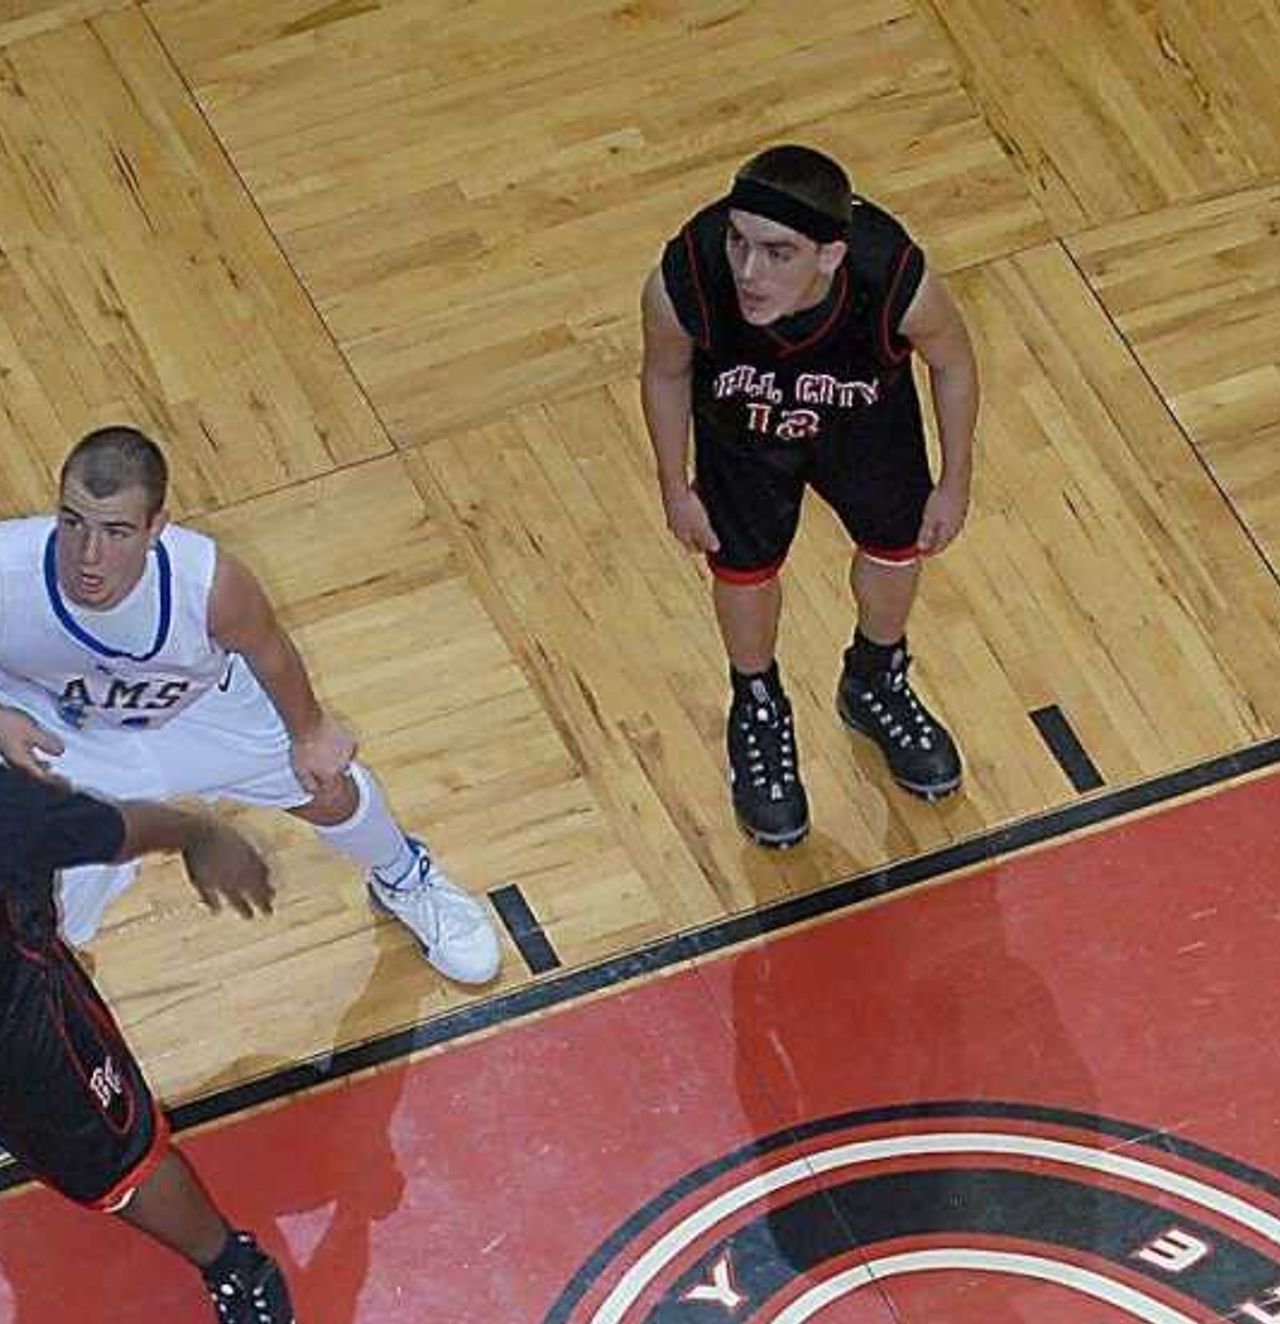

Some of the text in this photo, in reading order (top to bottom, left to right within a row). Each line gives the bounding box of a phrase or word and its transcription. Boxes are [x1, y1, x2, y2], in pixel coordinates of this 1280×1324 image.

[713, 364, 879, 408] ELL CITY
[59, 676, 188, 709] AMS
